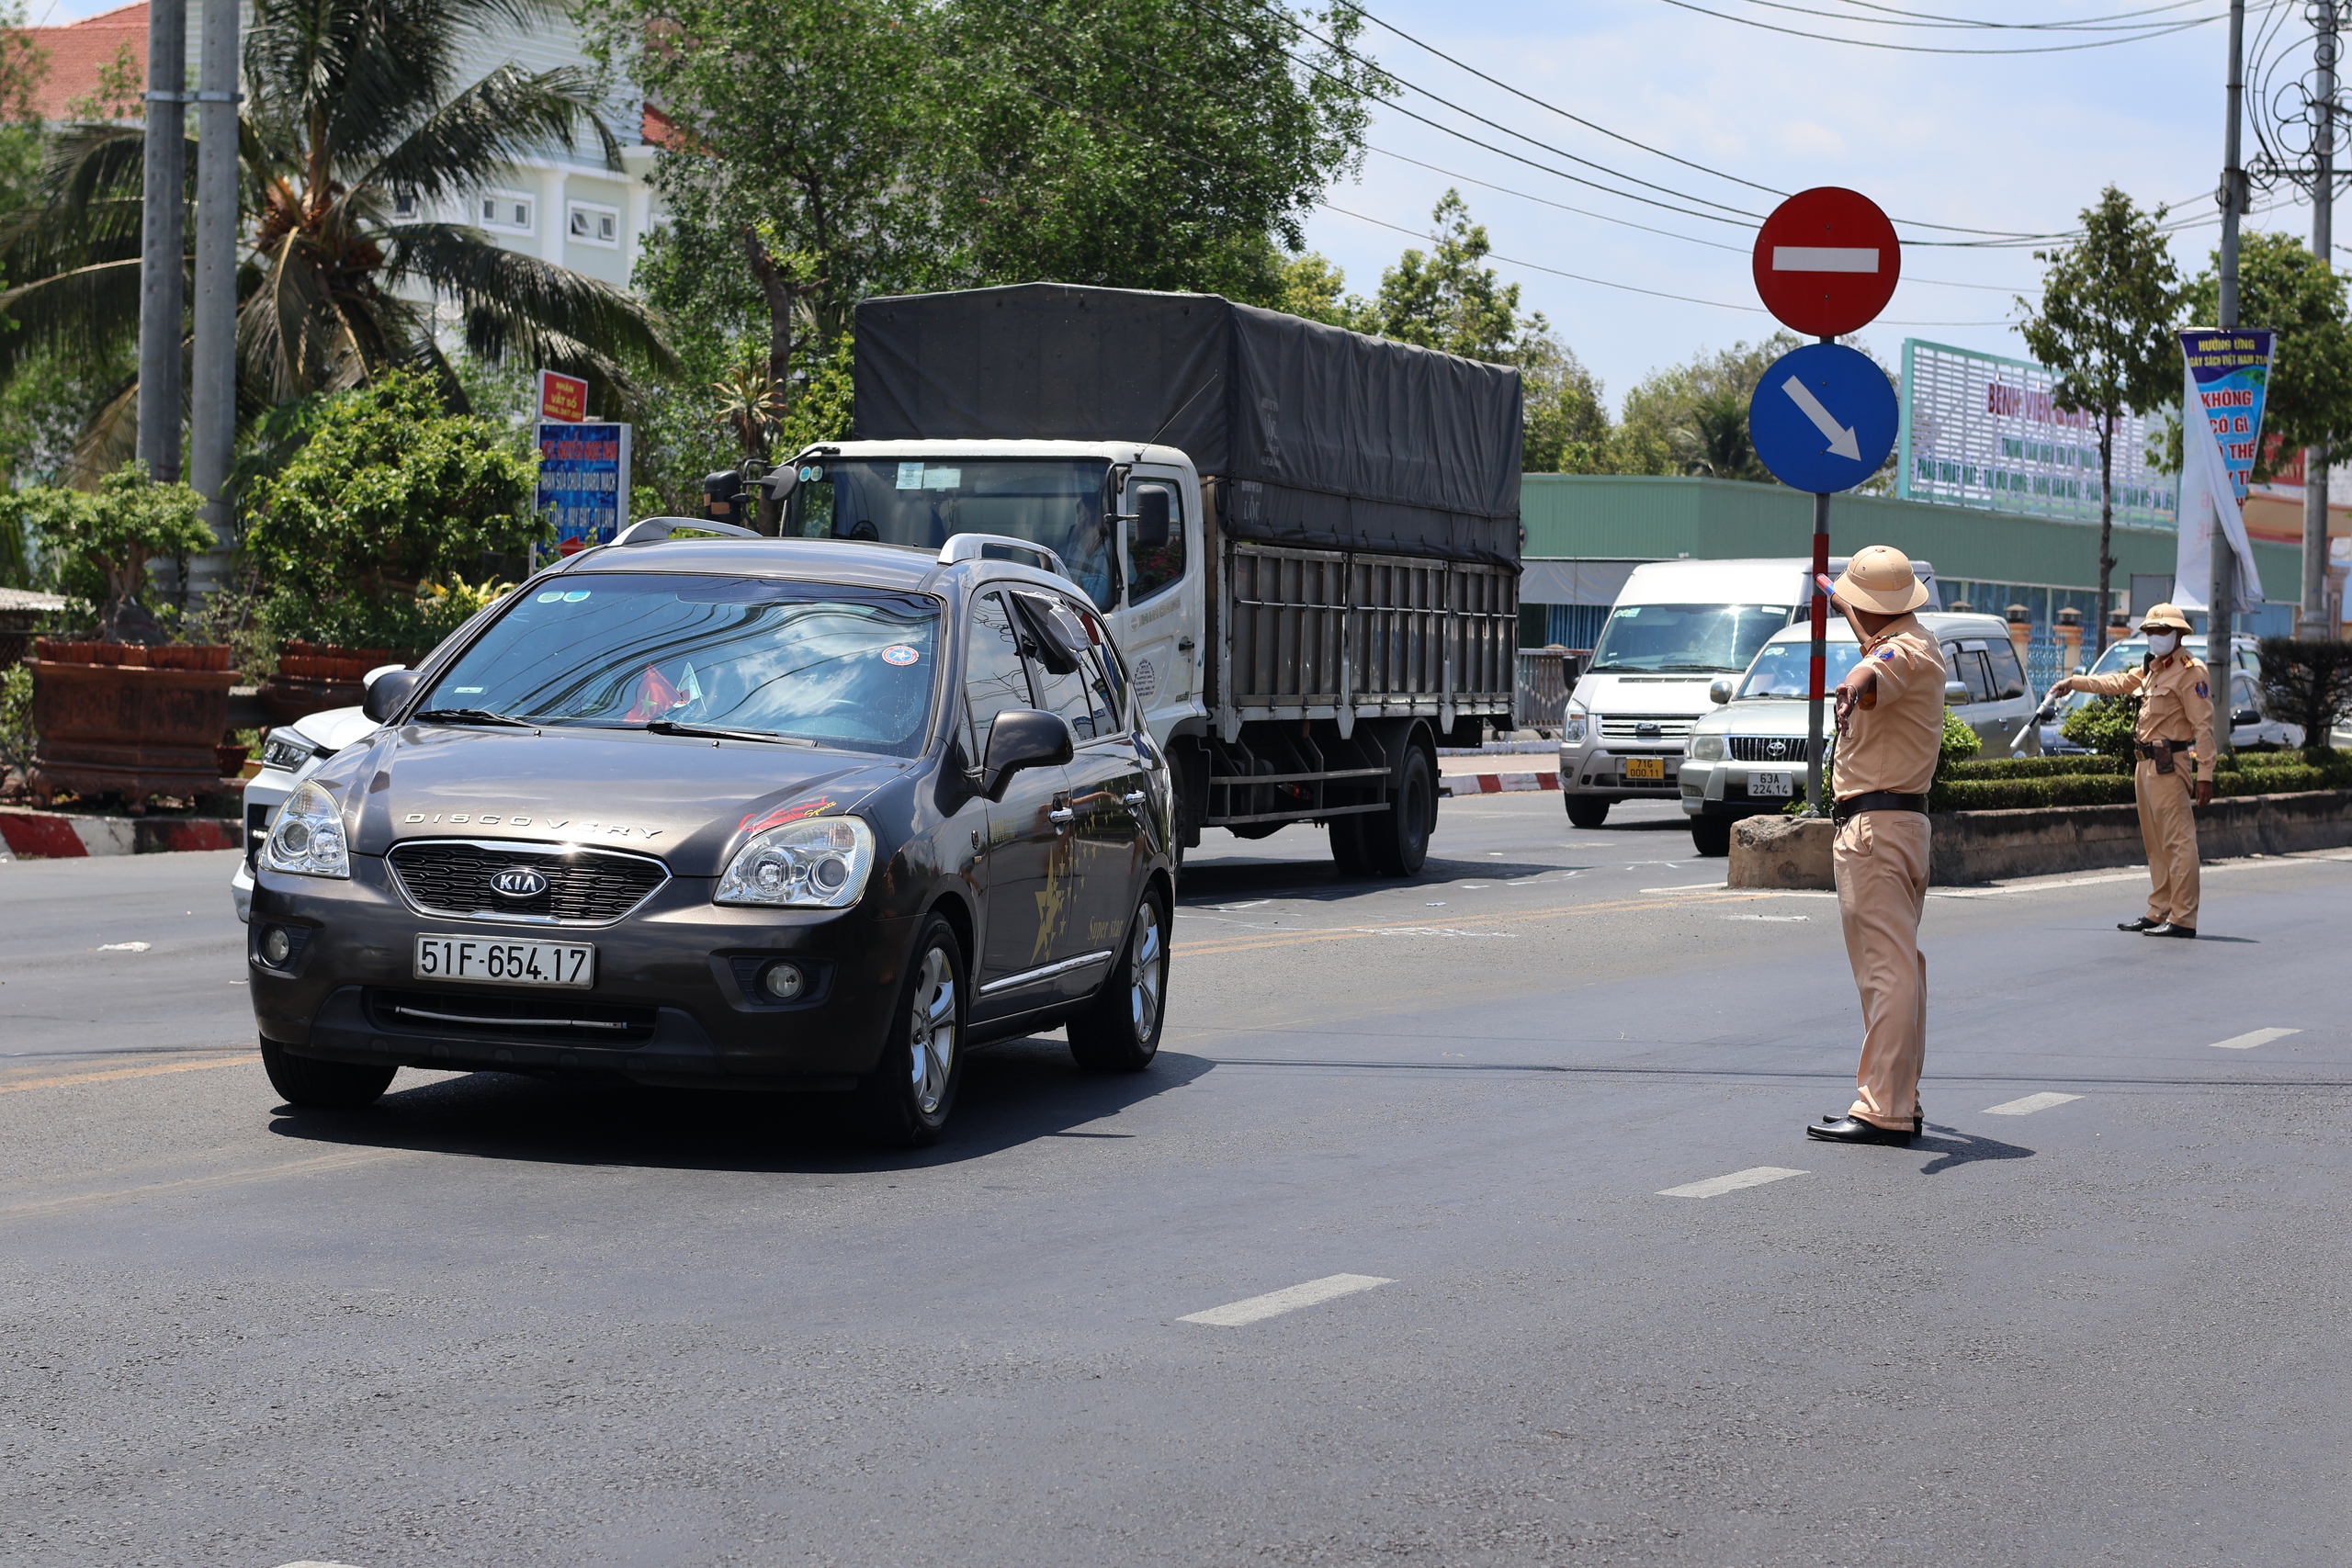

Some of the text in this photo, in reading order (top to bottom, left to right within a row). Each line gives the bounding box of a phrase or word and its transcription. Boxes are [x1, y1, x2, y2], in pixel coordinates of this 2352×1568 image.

[2199, 336, 2256, 352] HƯỞNG ỨNG
[2204, 354, 2222, 367] SÁCH
[2222, 353, 2236, 367] VIỆT
[2238, 355, 2255, 365] NAM
[2201, 388, 2253, 409] KHÔNG
[2234, 413, 2249, 434] GÌ
[1636, 760, 1653, 768] 71G
[1630, 769, 1659, 778] 000.11
[1759, 773, 1780, 784] 63A
[1753, 784, 1788, 795] 224.14
[405, 813, 663, 839] DISCOVERY
[499, 874, 537, 893] KIA
[1087, 916, 1124, 946] Super star
[421, 940, 587, 983] 51F-654.17
